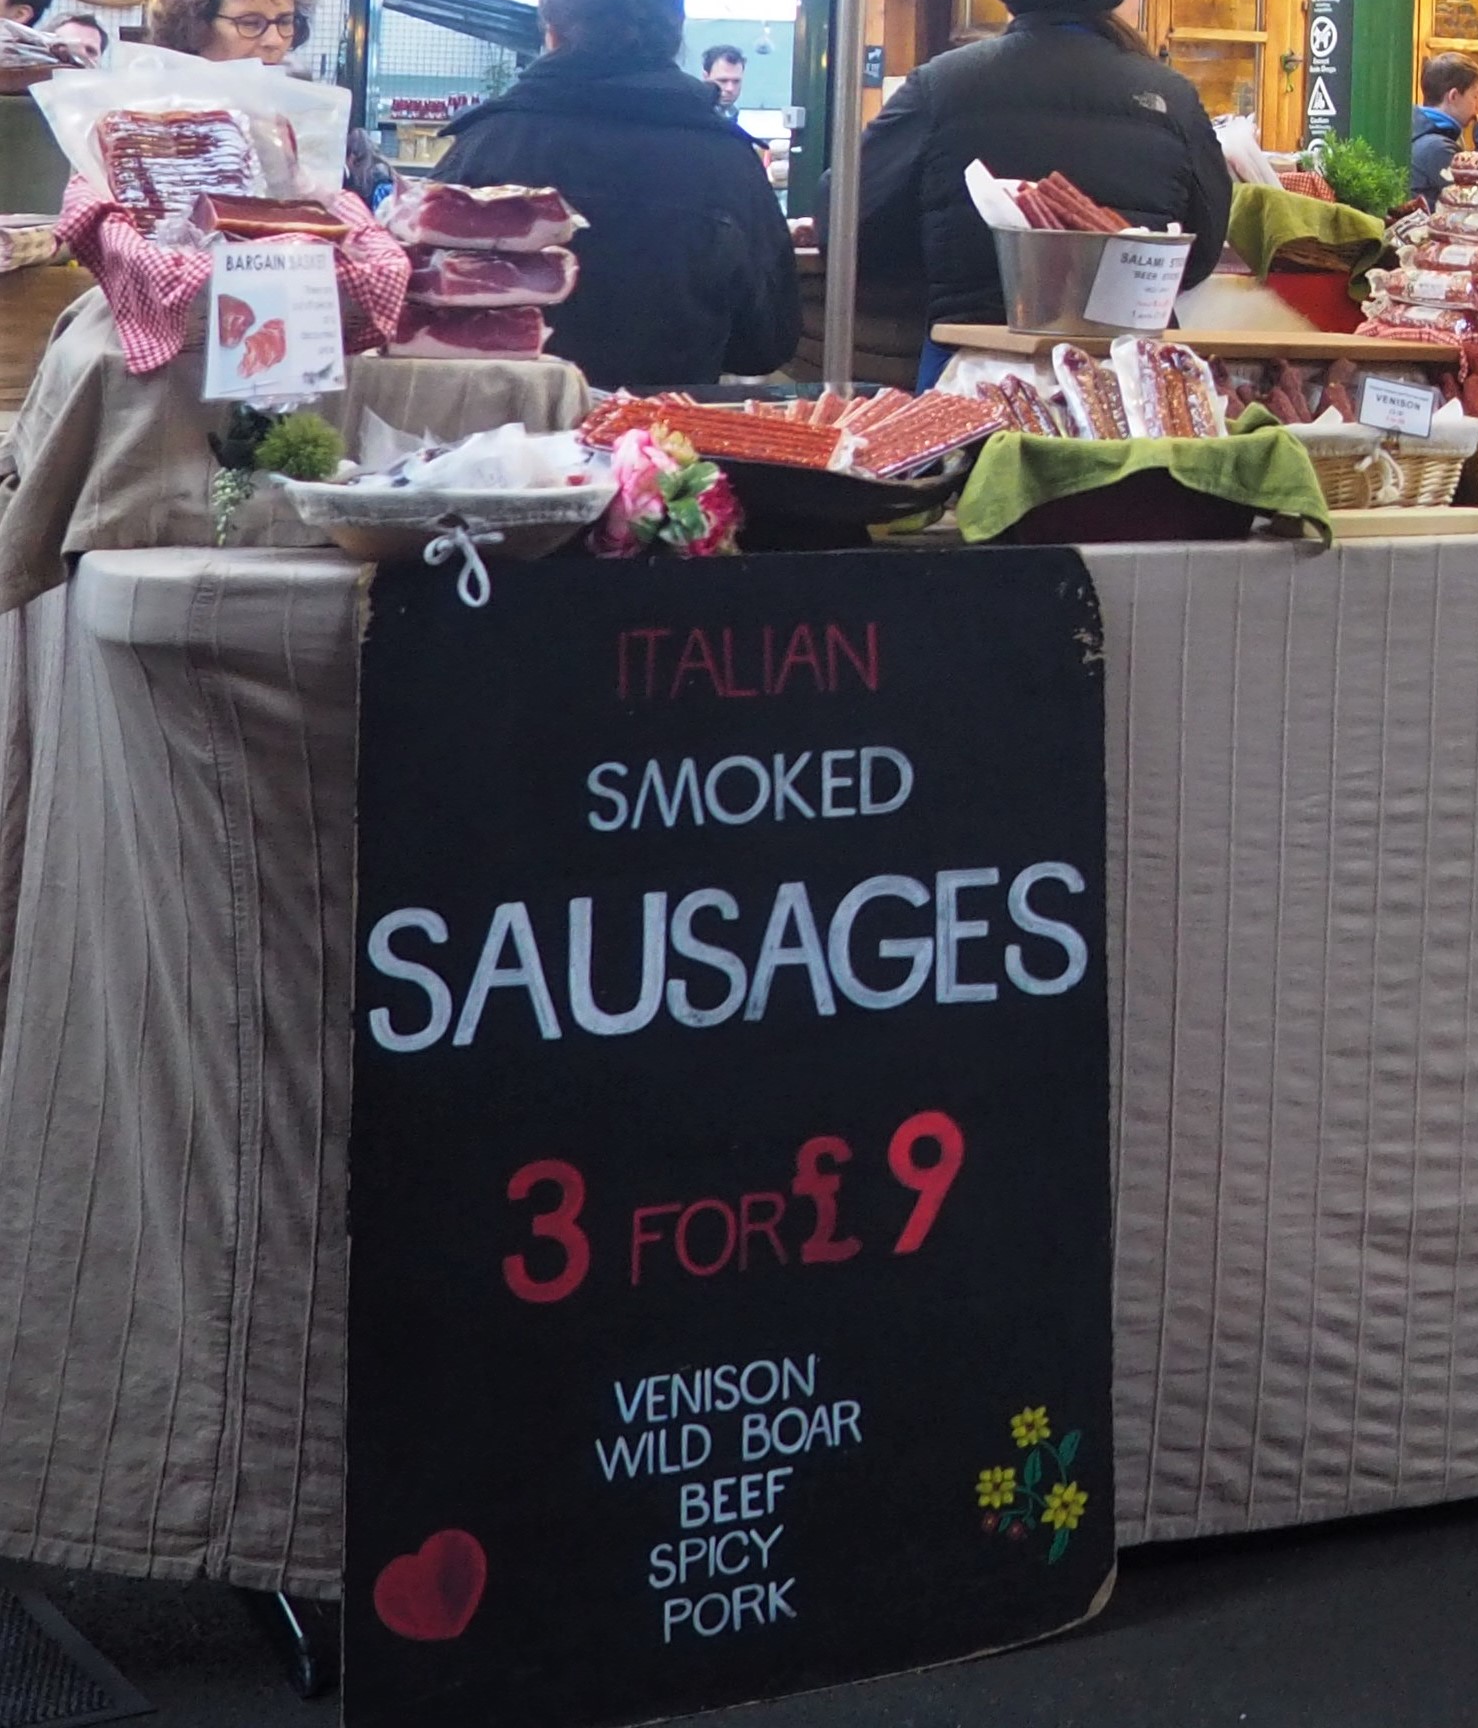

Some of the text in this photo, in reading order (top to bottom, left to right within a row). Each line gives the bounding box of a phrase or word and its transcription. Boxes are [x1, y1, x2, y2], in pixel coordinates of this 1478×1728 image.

[226, 254, 285, 272] BARGAIN
[1120, 252, 1164, 268] SALAMI
[1376, 393, 1420, 410] VENISON
[617, 622, 880, 700] ITALIAN
[587, 745, 915, 833] SMOKED
[367, 861, 1089, 1052] SAUSAGES
[503, 1159, 590, 1302] 3
[630, 1191, 788, 1286] FOR
[615, 1355, 816, 1424] VENISON
[595, 1400, 862, 1482] WILD BOAR
[680, 1465, 793, 1528] BEEF
[648, 1525, 783, 1588] SPICY
[663, 1578, 797, 1642] PORK
